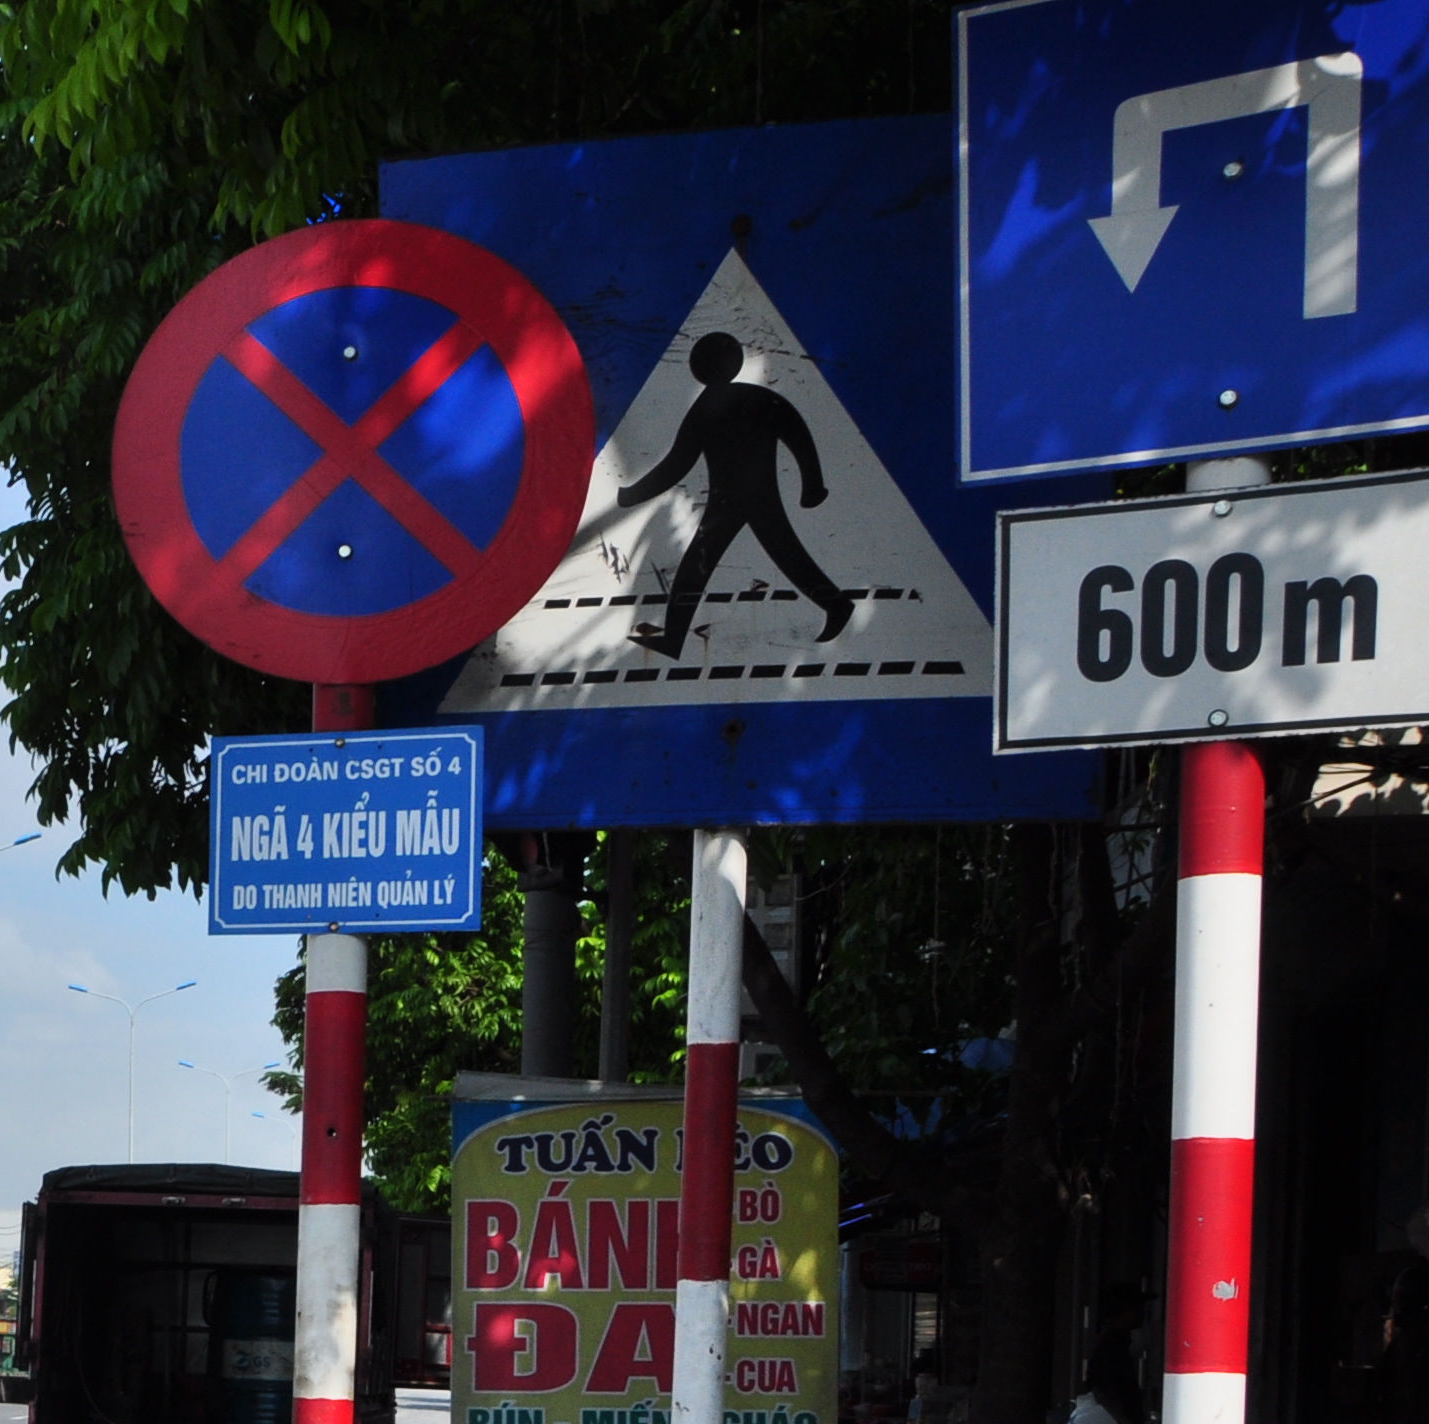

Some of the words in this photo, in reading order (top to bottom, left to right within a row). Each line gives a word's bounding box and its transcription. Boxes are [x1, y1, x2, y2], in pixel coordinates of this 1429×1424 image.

[231, 764, 268, 784] CHI
[274, 757, 339, 783] ĐOÀN
[345, 758, 405, 780] CSGT
[410, 747, 442, 777] SỐ
[447, 756, 462, 775] 4
[231, 805, 289, 862] NGÃ
[296, 814, 314, 860] 4
[322, 791, 387, 859] KIỂU
[395, 790, 461, 856] MẪU
[232, 885, 258, 910] DO
[262, 883, 323, 909] THANH
[327, 876, 372, 908] NIÊN
[377, 870, 428, 909] QUẢN
[433, 874, 456, 905] LÝ
[496, 1114, 659, 1174] TUẤN
